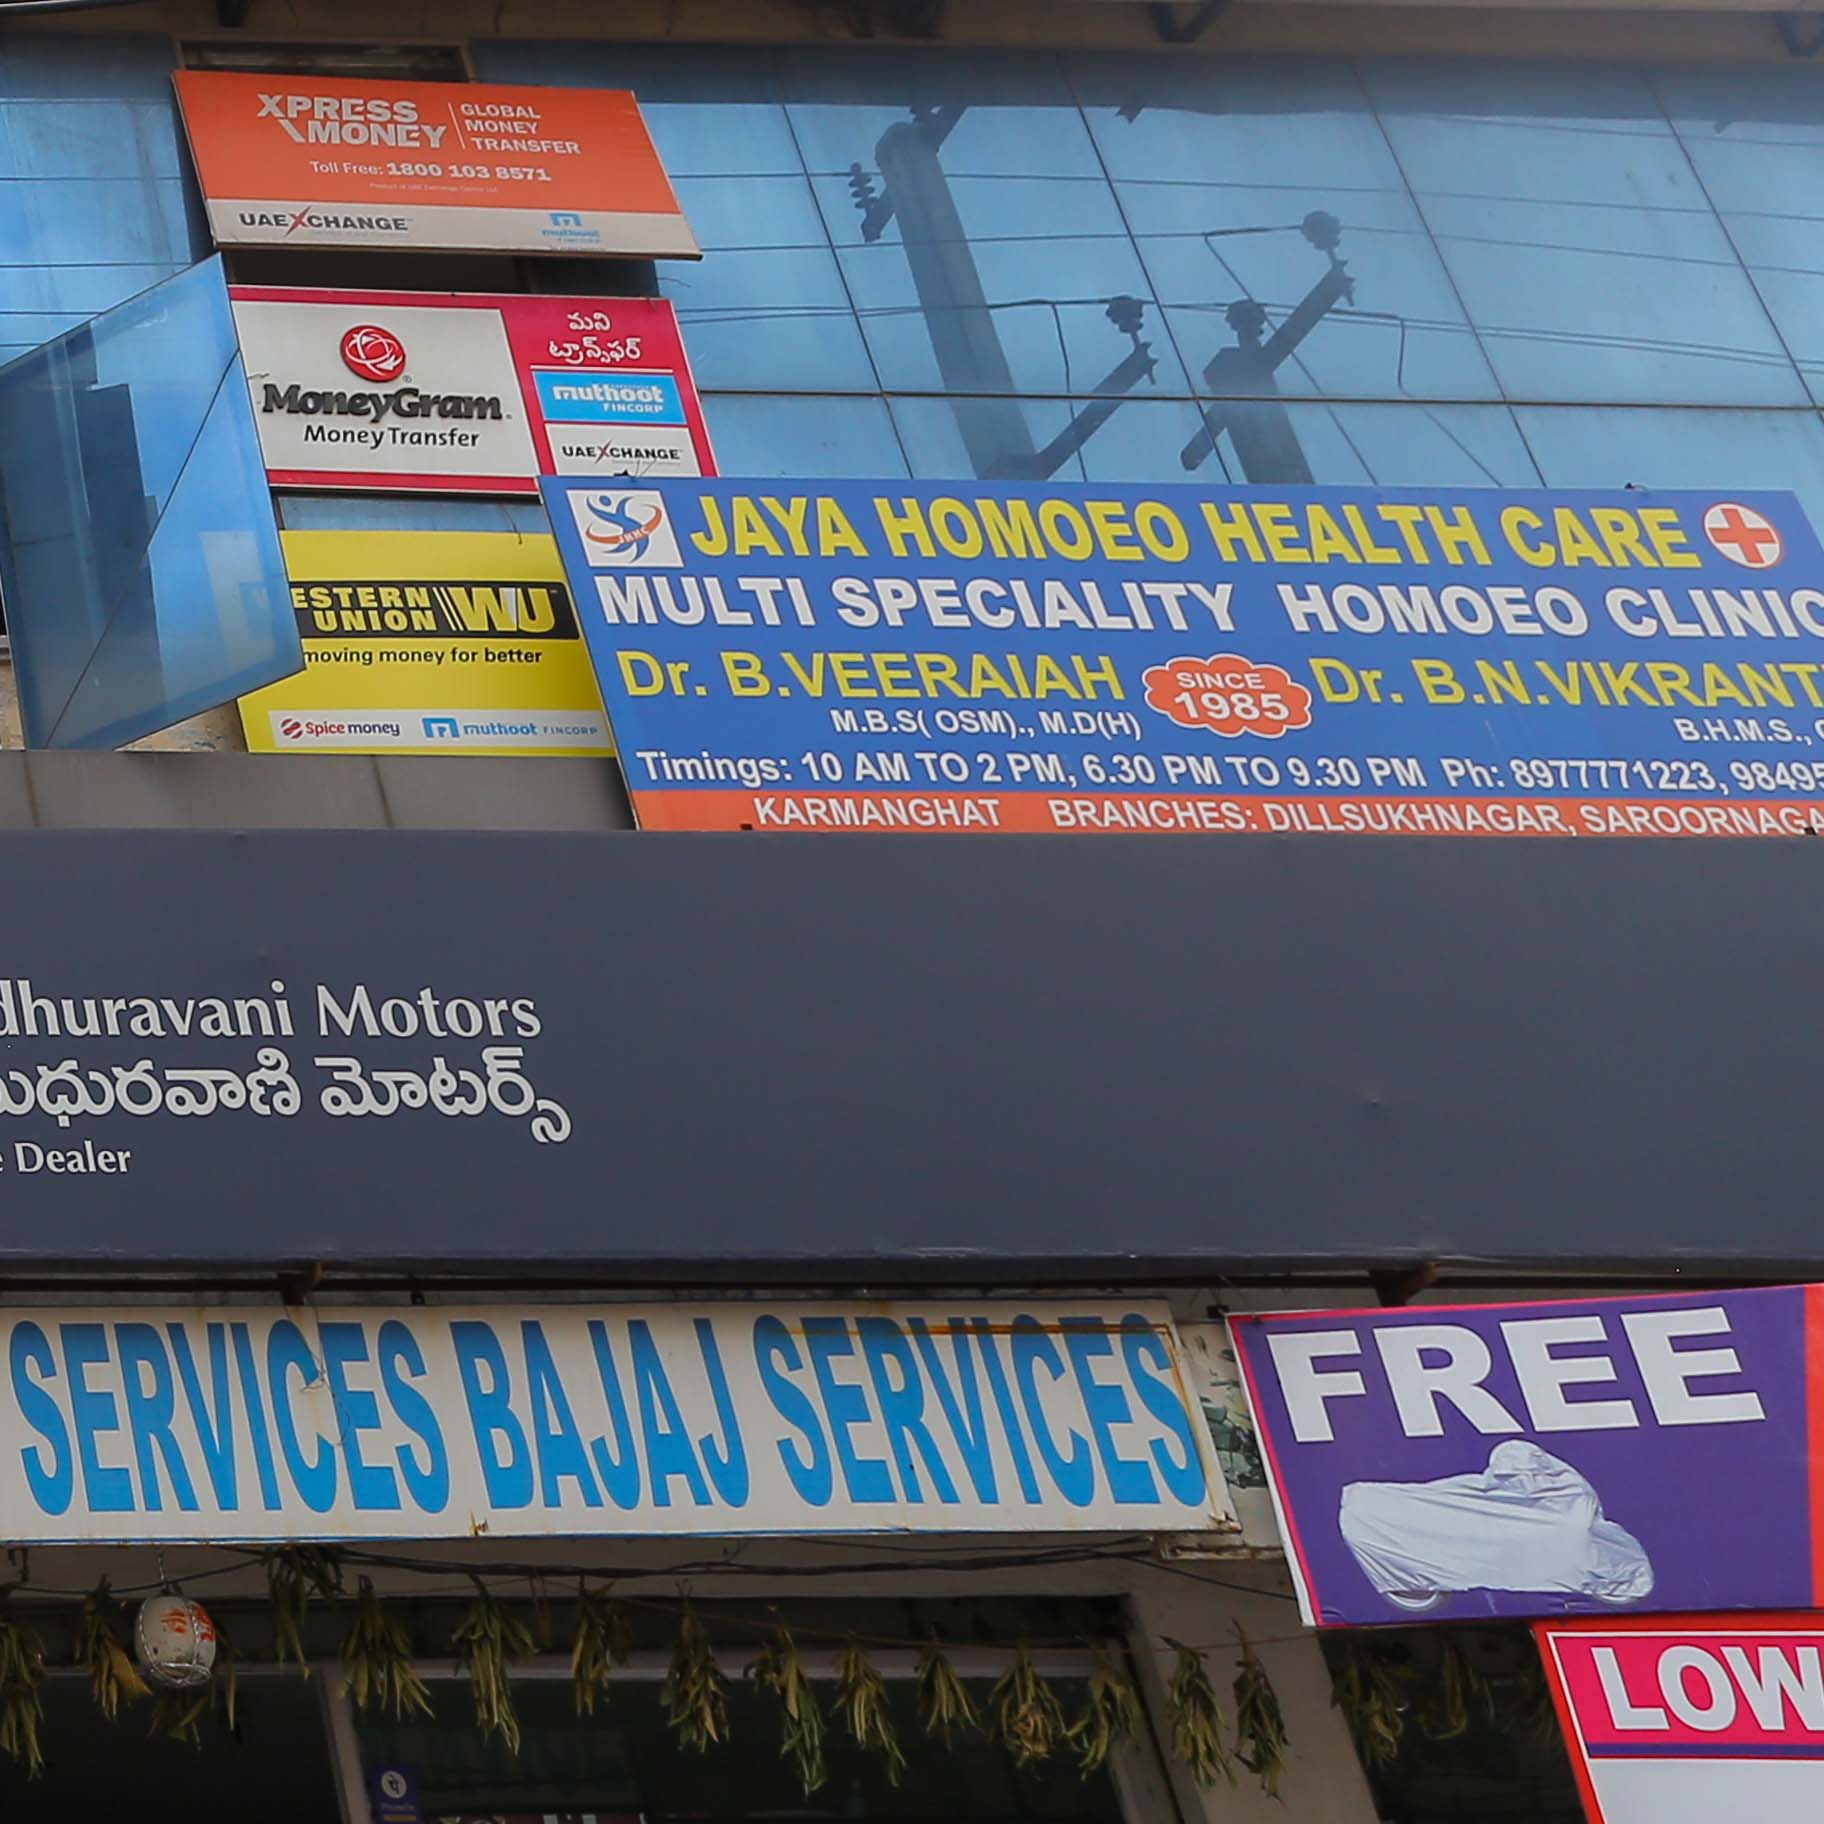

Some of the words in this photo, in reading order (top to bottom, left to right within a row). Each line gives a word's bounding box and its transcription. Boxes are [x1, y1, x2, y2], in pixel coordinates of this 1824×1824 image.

[257, 91, 419, 124] XPRESS
[460, 102, 541, 120] GLOBAL
[307, 120, 447, 149] MONEY
[464, 119, 539, 135] MONEY
[471, 136, 582, 155] TRANSFER
[309, 160, 339, 174] Toll
[342, 161, 384, 176] Free:
[386, 162, 443, 178] 1800
[448, 164, 490, 180] 103
[495, 166, 552, 182] 8571
[262, 383, 503, 423] MoneyGram
[303, 425, 385, 450] Money
[388, 427, 481, 448] Transfer
[690, 494, 868, 559] JAYA
[873, 496, 1190, 562] HOMOEO
[1199, 502, 1492, 567] HEALTH
[1499, 505, 1703, 570] CARE
[294, 586, 433, 609] ESTERN
[446, 586, 556, 633] WU
[593, 575, 816, 626] MULTI
[831, 577, 1237, 633] SPECIALITY
[1276, 583, 1590, 637] HOMOEO
[312, 609, 438, 632] UNION
[303, 647, 373, 666] moving
[379, 648, 445, 666] money
[451, 647, 477, 663] for
[484, 647, 543, 664] better
[616, 650, 708, 697] Dr.
[721, 651, 1126, 701] B.VEERAIAH
[1175, 671, 1266, 691] SINCE
[1307, 657, 1403, 704] Dr.
[1411, 659, 1824, 708] B.N.VIKRANT
[1172, 691, 1291, 722] 1985
[305, 720, 345, 737] Spice
[347, 722, 401, 737] money
[463, 722, 538, 736] muthoot
[1040, 711, 1142, 742] M.D(H)
[636, 751, 791, 788] Timings:
[800, 752, 843, 783] 10
[854, 752, 910, 784] AM
[915, 753, 970, 784] TO
[976, 753, 999, 784] 2
[1006, 754, 1078, 789] PM,
[1084, 755, 1155, 786] 6.30
[1166, 755, 1220, 786] PM
[1227, 756, 1280, 787] TO
[1288, 757, 1361, 788] 9.30
[1366, 757, 1427, 788] PM
[1440, 758, 1504, 789] Ph:
[752, 796, 1001, 829] KARMANGHAT
[1047, 798, 1258, 832] BRANCHES:
[1266, 801, 1578, 836] DILLSUKHNAGAR,
[314, 982, 542, 1040] Motors
[13, 1141, 133, 1177] Dealer
[1265, 1305, 1768, 1444] FREE
[17, 1319, 452, 1517] SERVICES
[449, 1317, 750, 1512] BAJAJ
[752, 1313, 1208, 1511] SERVICES
[1590, 1644, 1824, 1733] LOW
